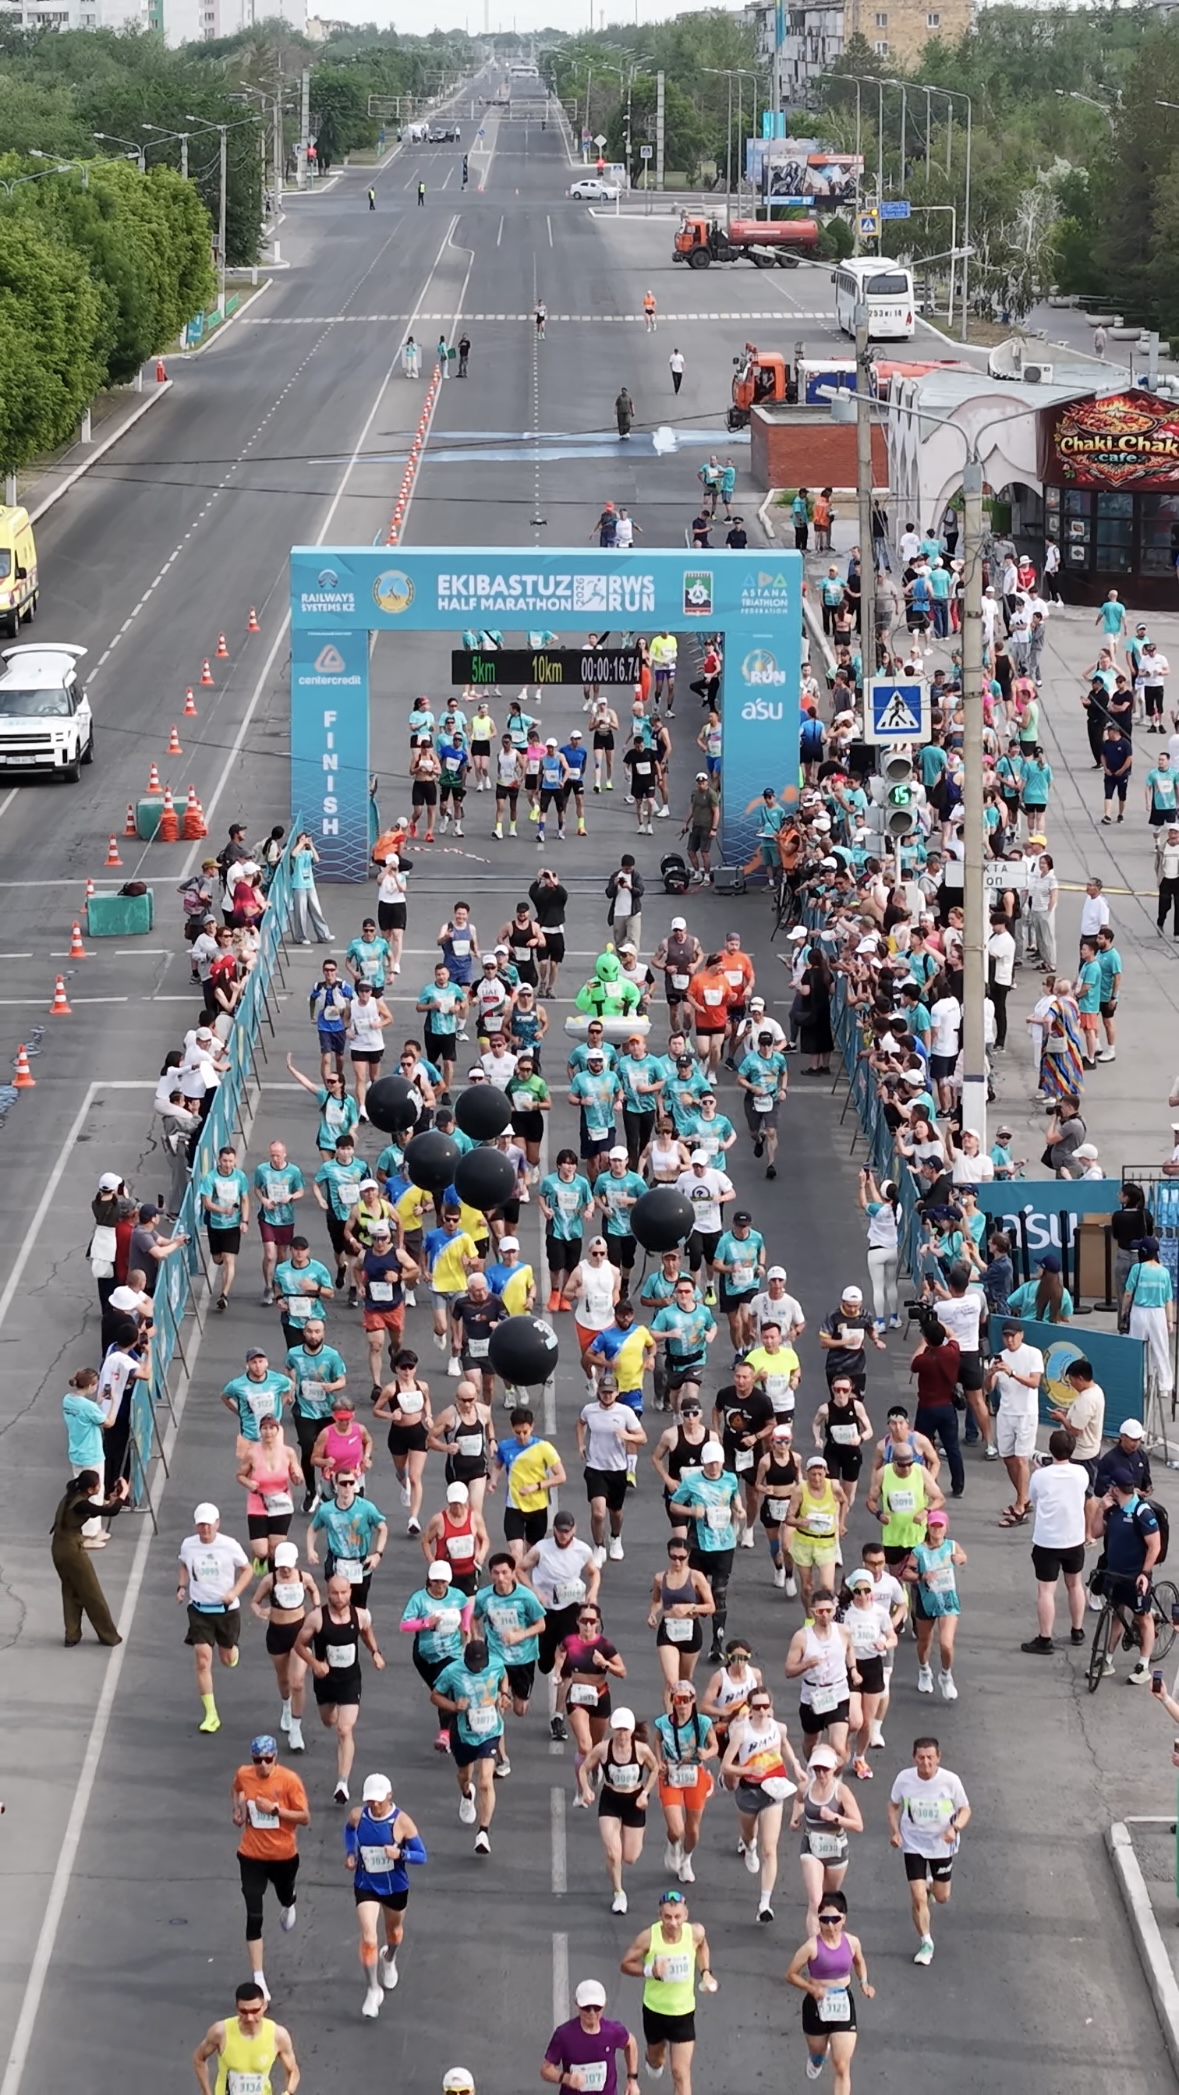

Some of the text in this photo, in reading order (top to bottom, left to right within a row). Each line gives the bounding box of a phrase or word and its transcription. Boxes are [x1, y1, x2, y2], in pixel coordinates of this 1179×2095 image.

[1098, 453, 1138, 462] cafe
[437, 574, 571, 595] EKIBASTUZ
[575, 577, 585, 606] 2026
[608, 575, 655, 594] RWS
[301, 593, 354, 602] RAILWAYS
[741, 589, 788, 597] ASTANA
[301, 603, 355, 612] SYSTEMS KZ
[438, 597, 571, 611] HALF MARATHON
[608, 594, 655, 611] RUN
[741, 599, 788, 607] TRIATHLON
[471, 656, 496, 682] 5km
[532, 656, 563, 682] 10km
[298, 675, 361, 686] centercredit
[750, 670, 786, 684] RUN
[322, 710, 339, 835] FINISH
